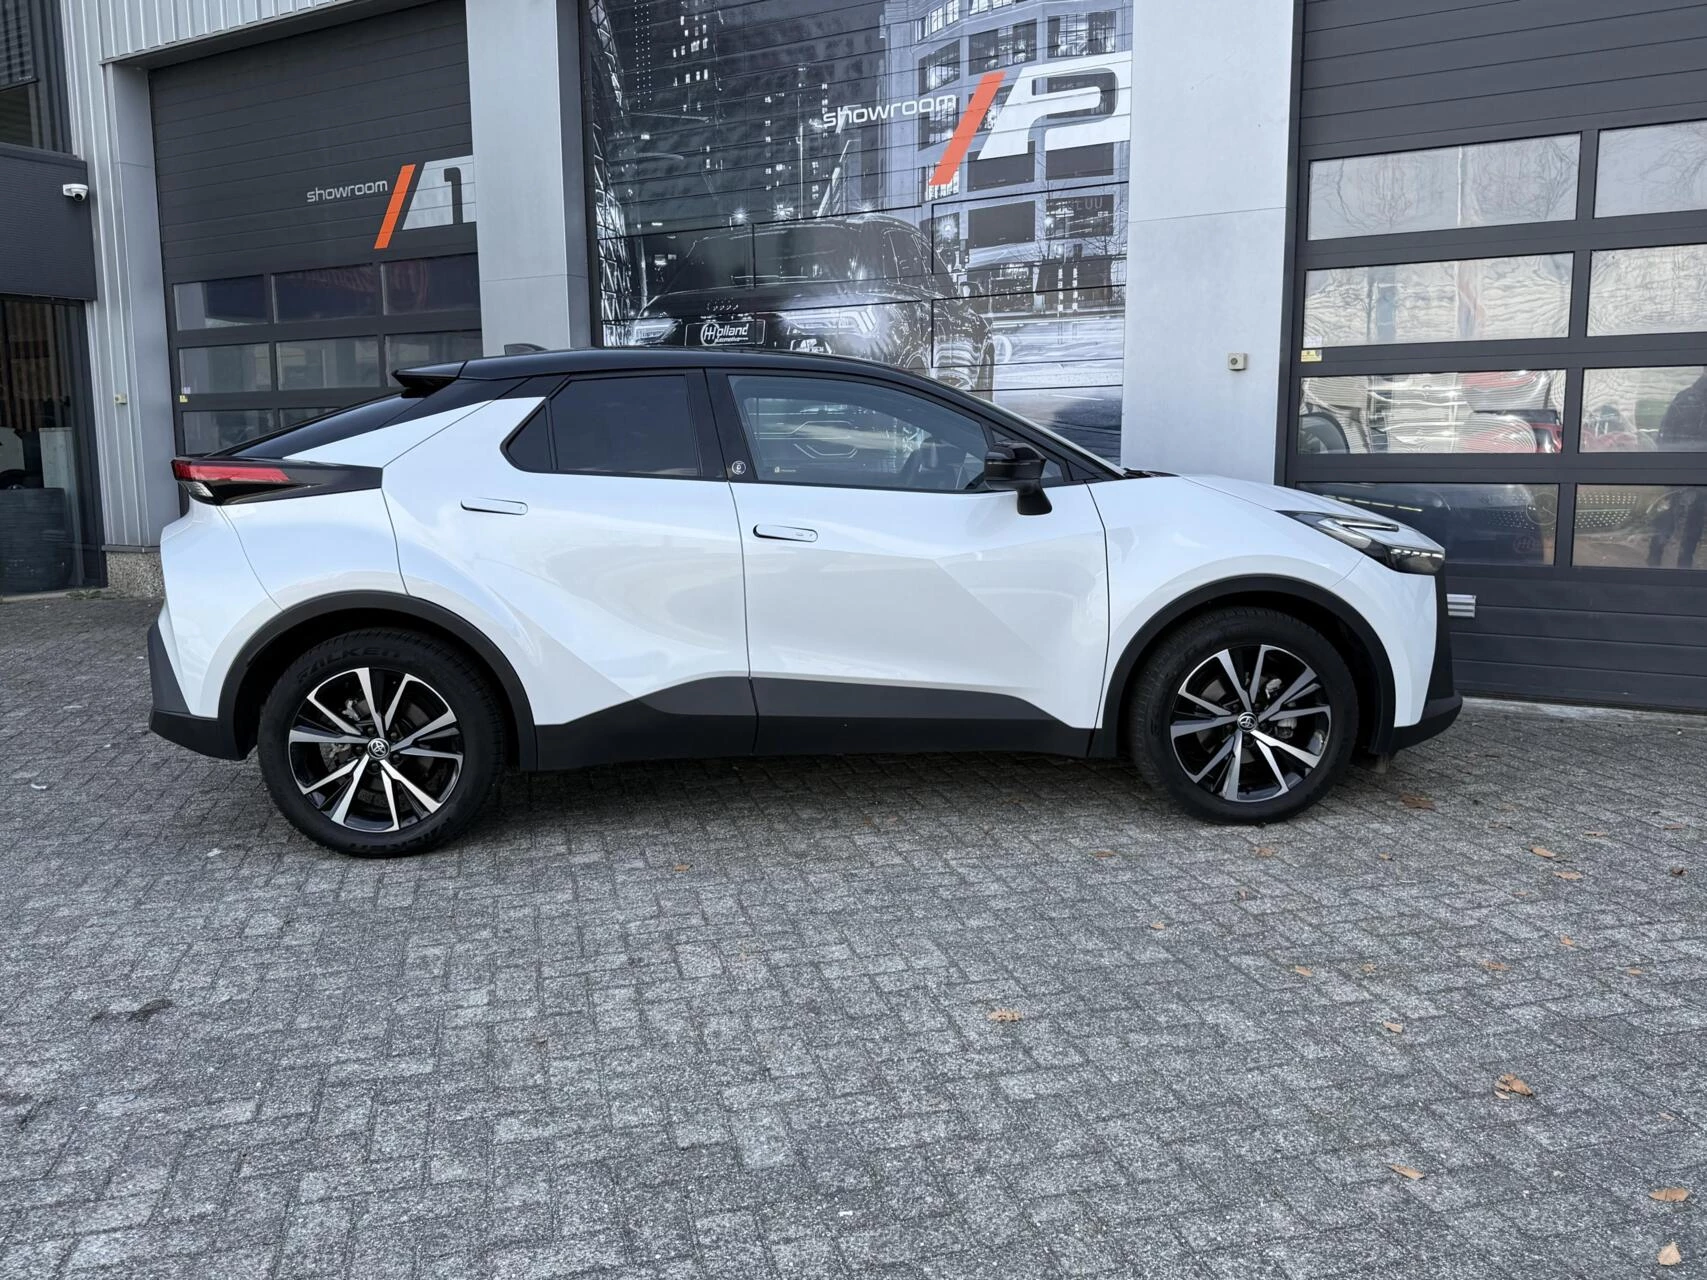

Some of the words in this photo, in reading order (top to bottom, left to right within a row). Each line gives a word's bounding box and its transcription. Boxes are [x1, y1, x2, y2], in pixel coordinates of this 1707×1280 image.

[822, 93, 957, 128] showroom
[306, 180, 388, 202] showroom
[701, 323, 749, 342] Holland
